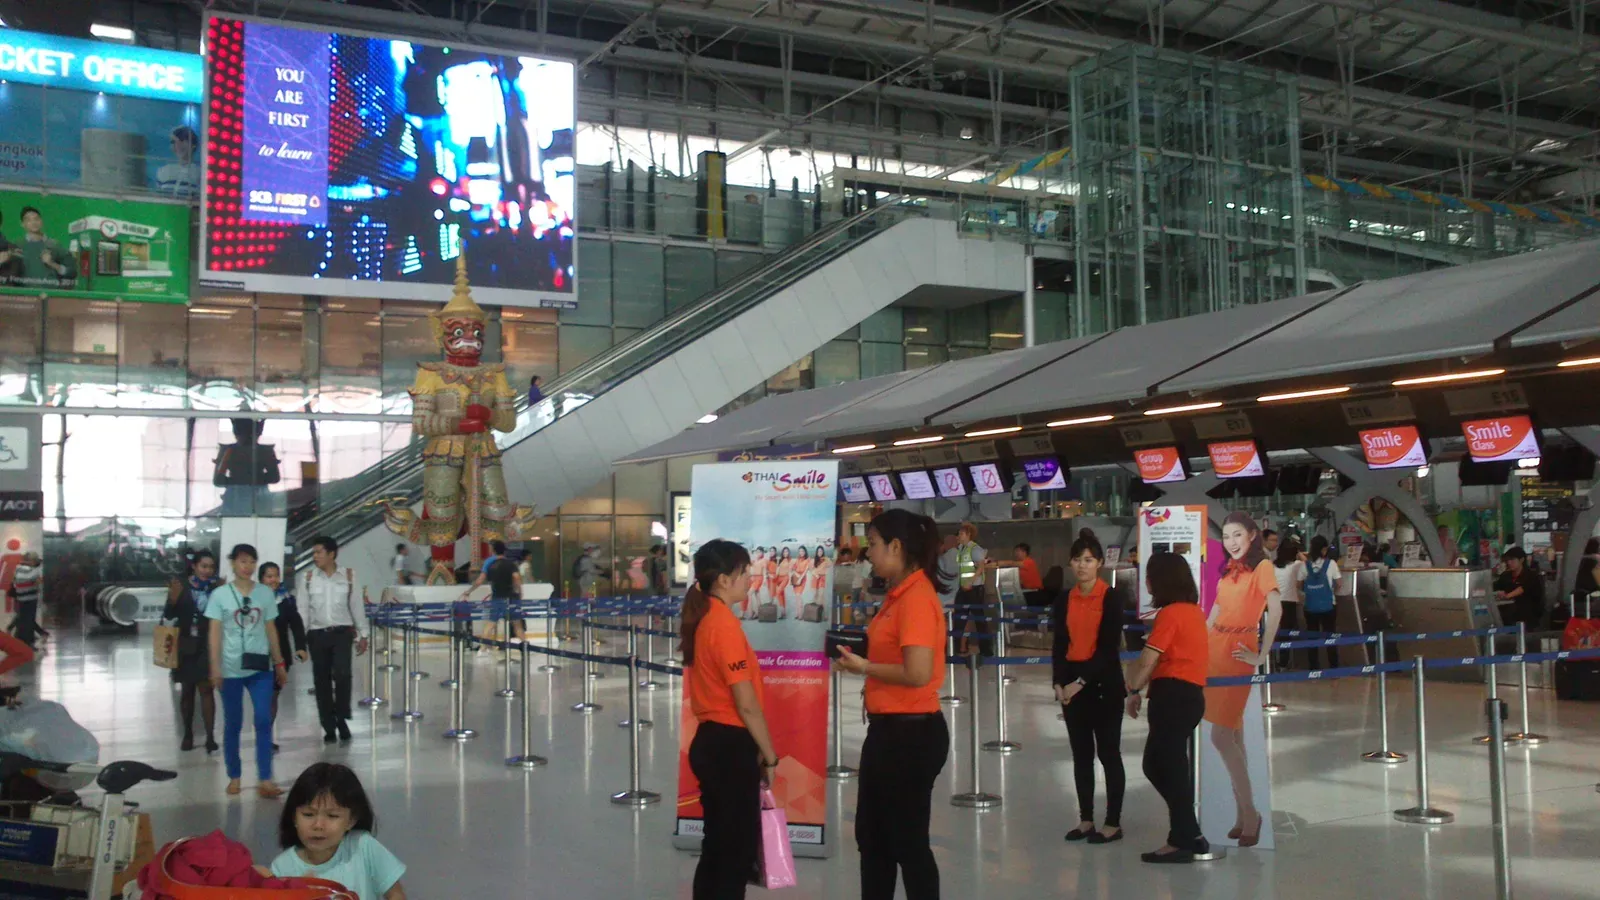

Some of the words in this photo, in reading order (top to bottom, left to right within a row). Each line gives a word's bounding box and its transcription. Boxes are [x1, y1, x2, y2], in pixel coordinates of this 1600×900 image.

[83, 55, 184, 92] OFFICE
[275, 67, 305, 83] YOU
[274, 89, 304, 105] ARE
[268, 111, 309, 128] FIRST
[258, 144, 274, 156] to
[276, 141, 313, 160] learn
[249, 190, 273, 204] SCB
[275, 192, 307, 207] FIRST
[1467, 421, 1512, 441] Smile
[1363, 431, 1402, 449] Smile
[1471, 440, 1496, 451] Class
[1139, 453, 1164, 465] Group
[1367, 448, 1388, 458] Class
[755, 473, 779, 481] THAI
[773, 470, 829, 489] Smile
[4, 500, 37, 511] AOT
[728, 660, 748, 671] WE
[757, 656, 774, 665] mile
[776, 655, 822, 666] Generation
[1461, 657, 1475, 665] AOT
[1251, 674, 1266, 683] AOT
[1308, 670, 1322, 679] AOT
[1361, 665, 1376, 673] AOT
